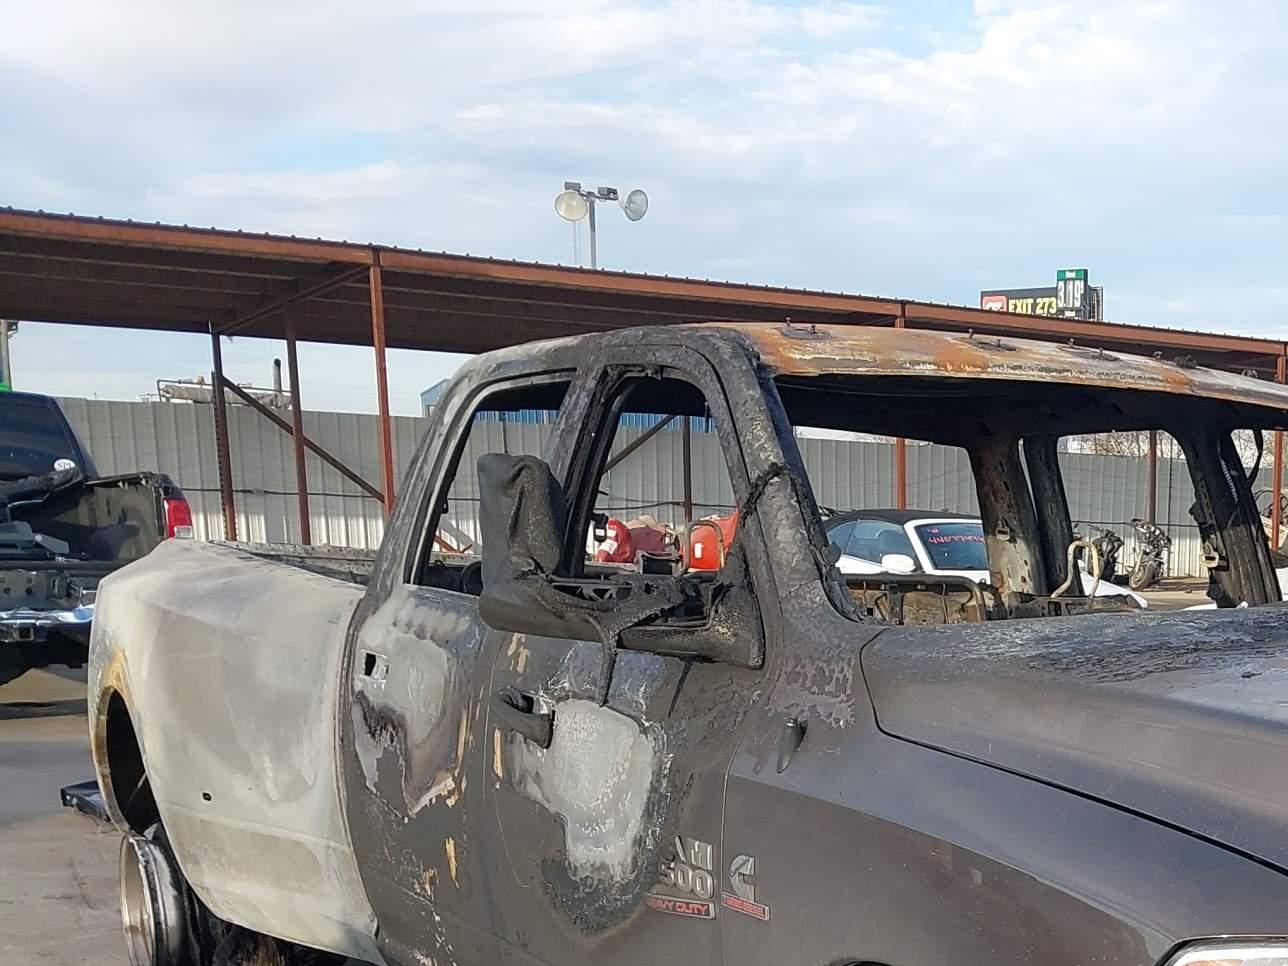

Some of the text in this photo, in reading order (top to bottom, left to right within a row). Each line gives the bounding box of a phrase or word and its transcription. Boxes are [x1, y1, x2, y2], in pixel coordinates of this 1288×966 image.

[1008, 298, 1034, 314] EXIT
[1035, 296, 1056, 314] 273
[675, 902, 708, 914] DUTY
